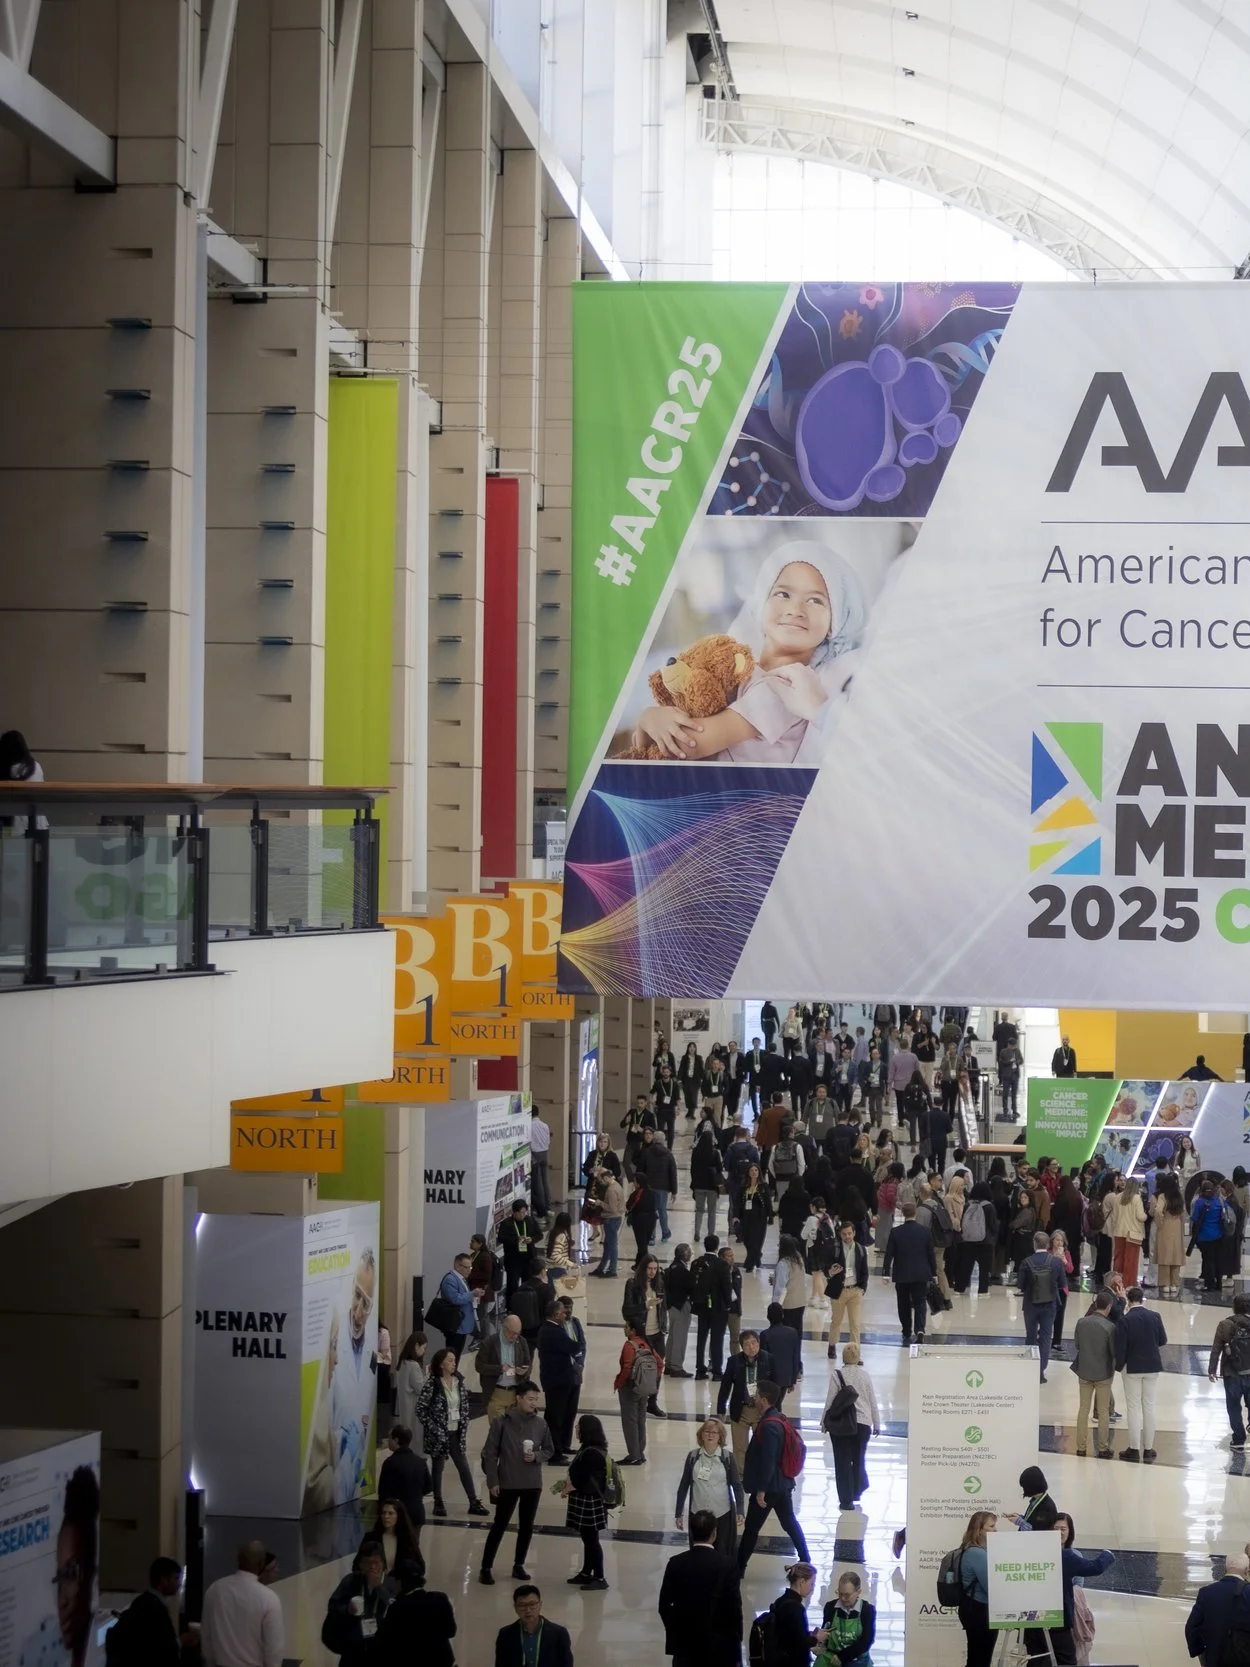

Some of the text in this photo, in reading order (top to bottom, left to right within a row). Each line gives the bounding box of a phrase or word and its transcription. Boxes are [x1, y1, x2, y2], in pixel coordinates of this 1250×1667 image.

[594, 336, 722, 586] #AACR25
[1040, 608, 1102, 648] for
[1027, 884, 1200, 943] 2025
[1053, 1091, 1088, 1100] CANCER
[1040, 1099, 1076, 1108] SCIENCE
[1035, 1121, 1088, 1129] INNOVATION
[235, 1127, 337, 1151] NORTH
[1056, 1130, 1087, 1138] IMPACT
[426, 1188, 465, 1204] HALL
[232, 1337, 287, 1359] HALL
[995, 1562, 1055, 1572] NEED HELP?
[1005, 1572, 1046, 1582] ASK ME!
